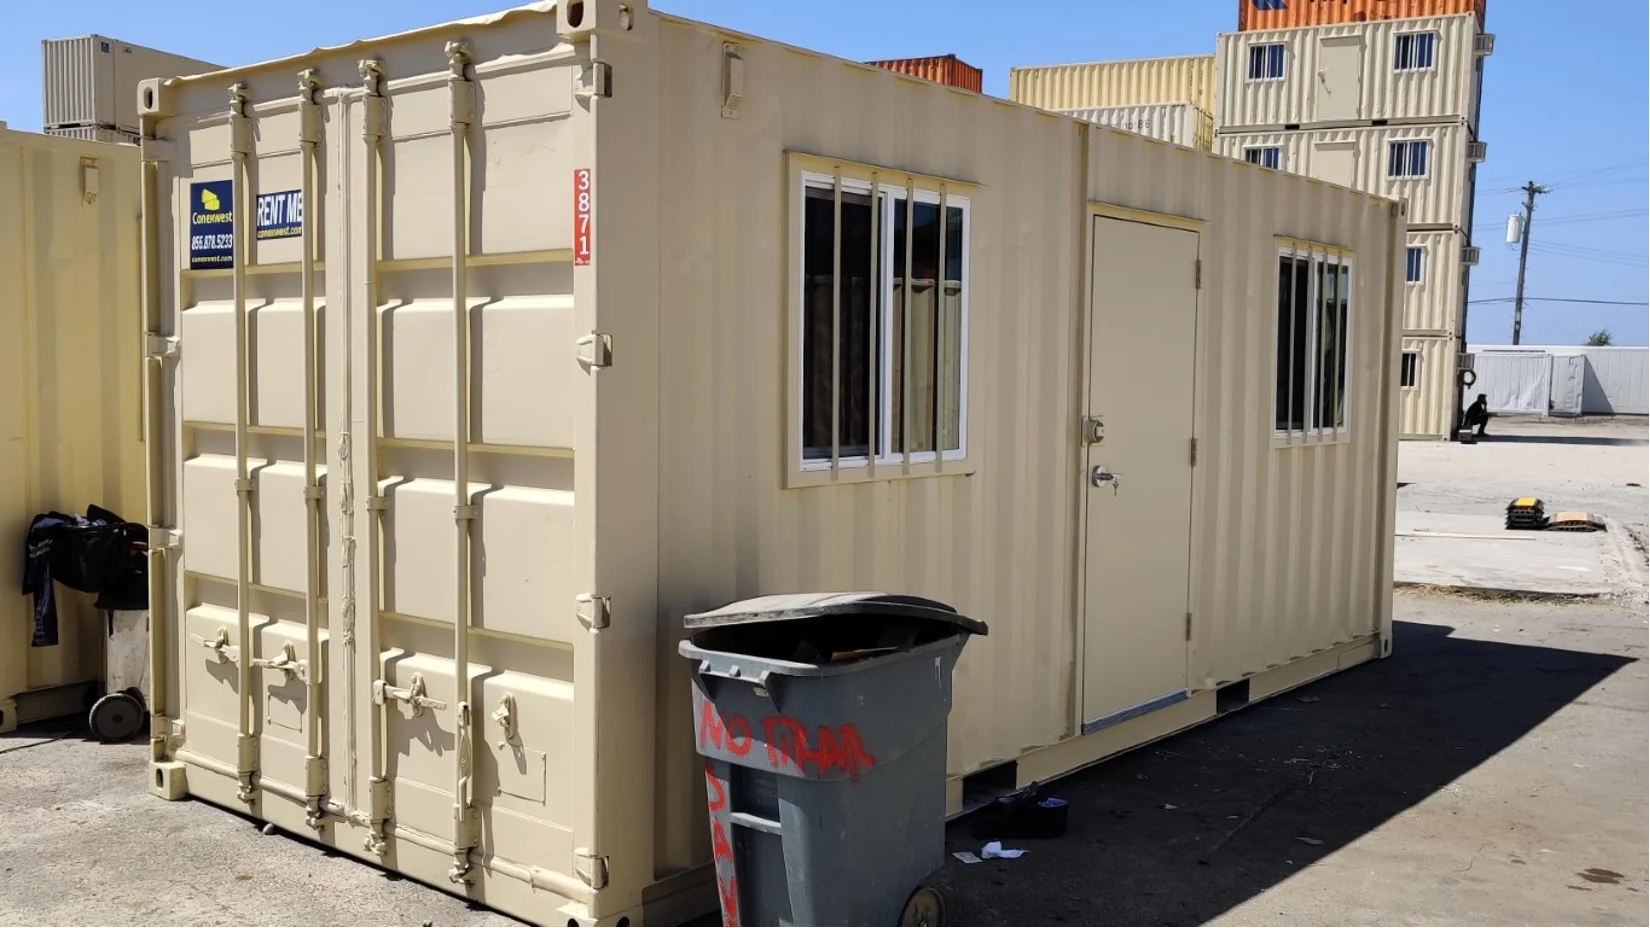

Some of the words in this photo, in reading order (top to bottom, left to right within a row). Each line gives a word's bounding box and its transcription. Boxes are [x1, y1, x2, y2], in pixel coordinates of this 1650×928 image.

[192, 210, 233, 225] Conexwest
[257, 194, 286, 226] RENT
[578, 170, 590, 255] 3871
[257, 226, 302, 238] conexwest.com
[700, 700, 752, 757] NO
